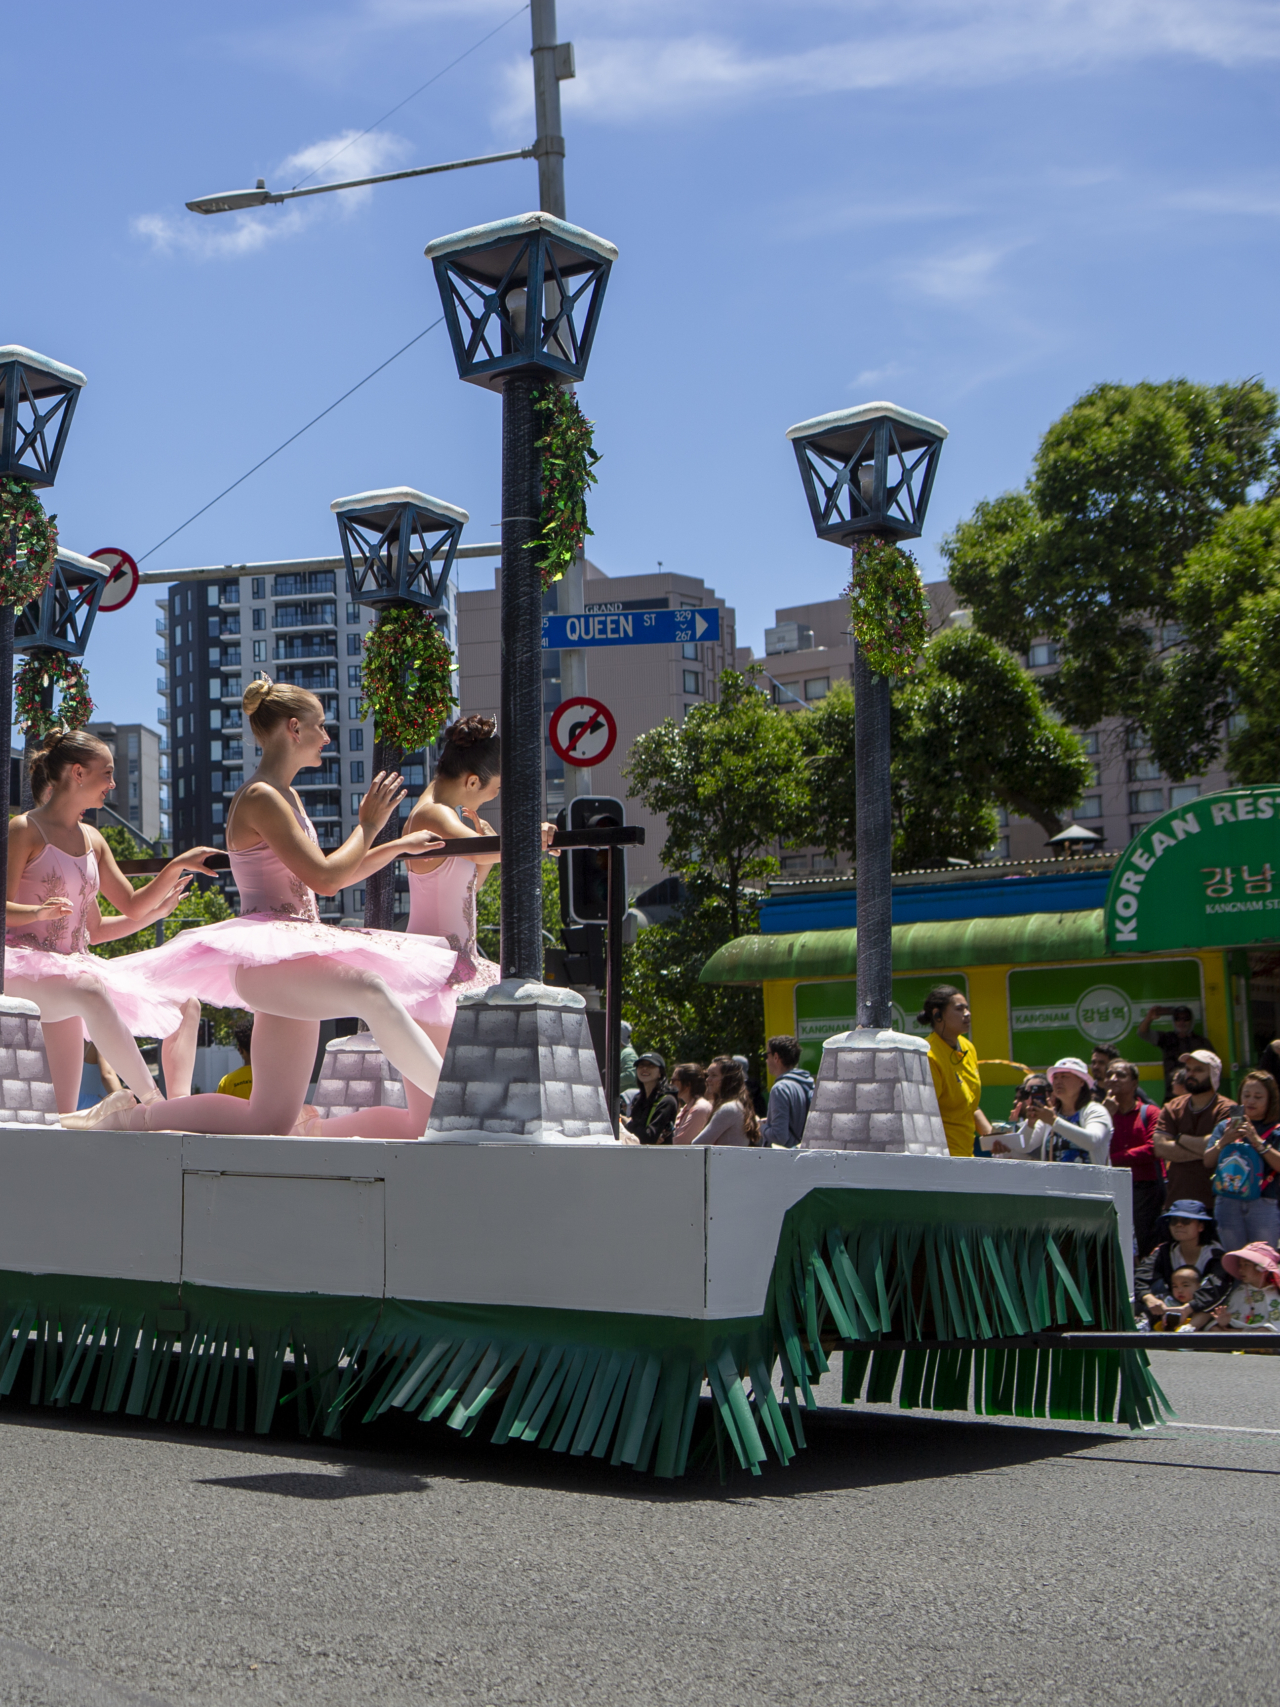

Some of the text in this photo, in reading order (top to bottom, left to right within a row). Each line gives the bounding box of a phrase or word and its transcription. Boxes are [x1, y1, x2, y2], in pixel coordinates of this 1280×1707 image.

[585, 602, 623, 614] GRAND
[674, 610, 692, 622] 329
[566, 613, 657, 641] QUEEN ST
[675, 630, 692, 642] 267
[1114, 811, 1202, 942] KOREAN
[1199, 863, 1277, 898] 강남
[1205, 899, 1280, 915] KANGNAM ST
[1015, 1012, 1069, 1024] KANGNAM
[1082, 1006, 1126, 1023] 강남역
[800, 1023, 850, 1035] KANGNAM
